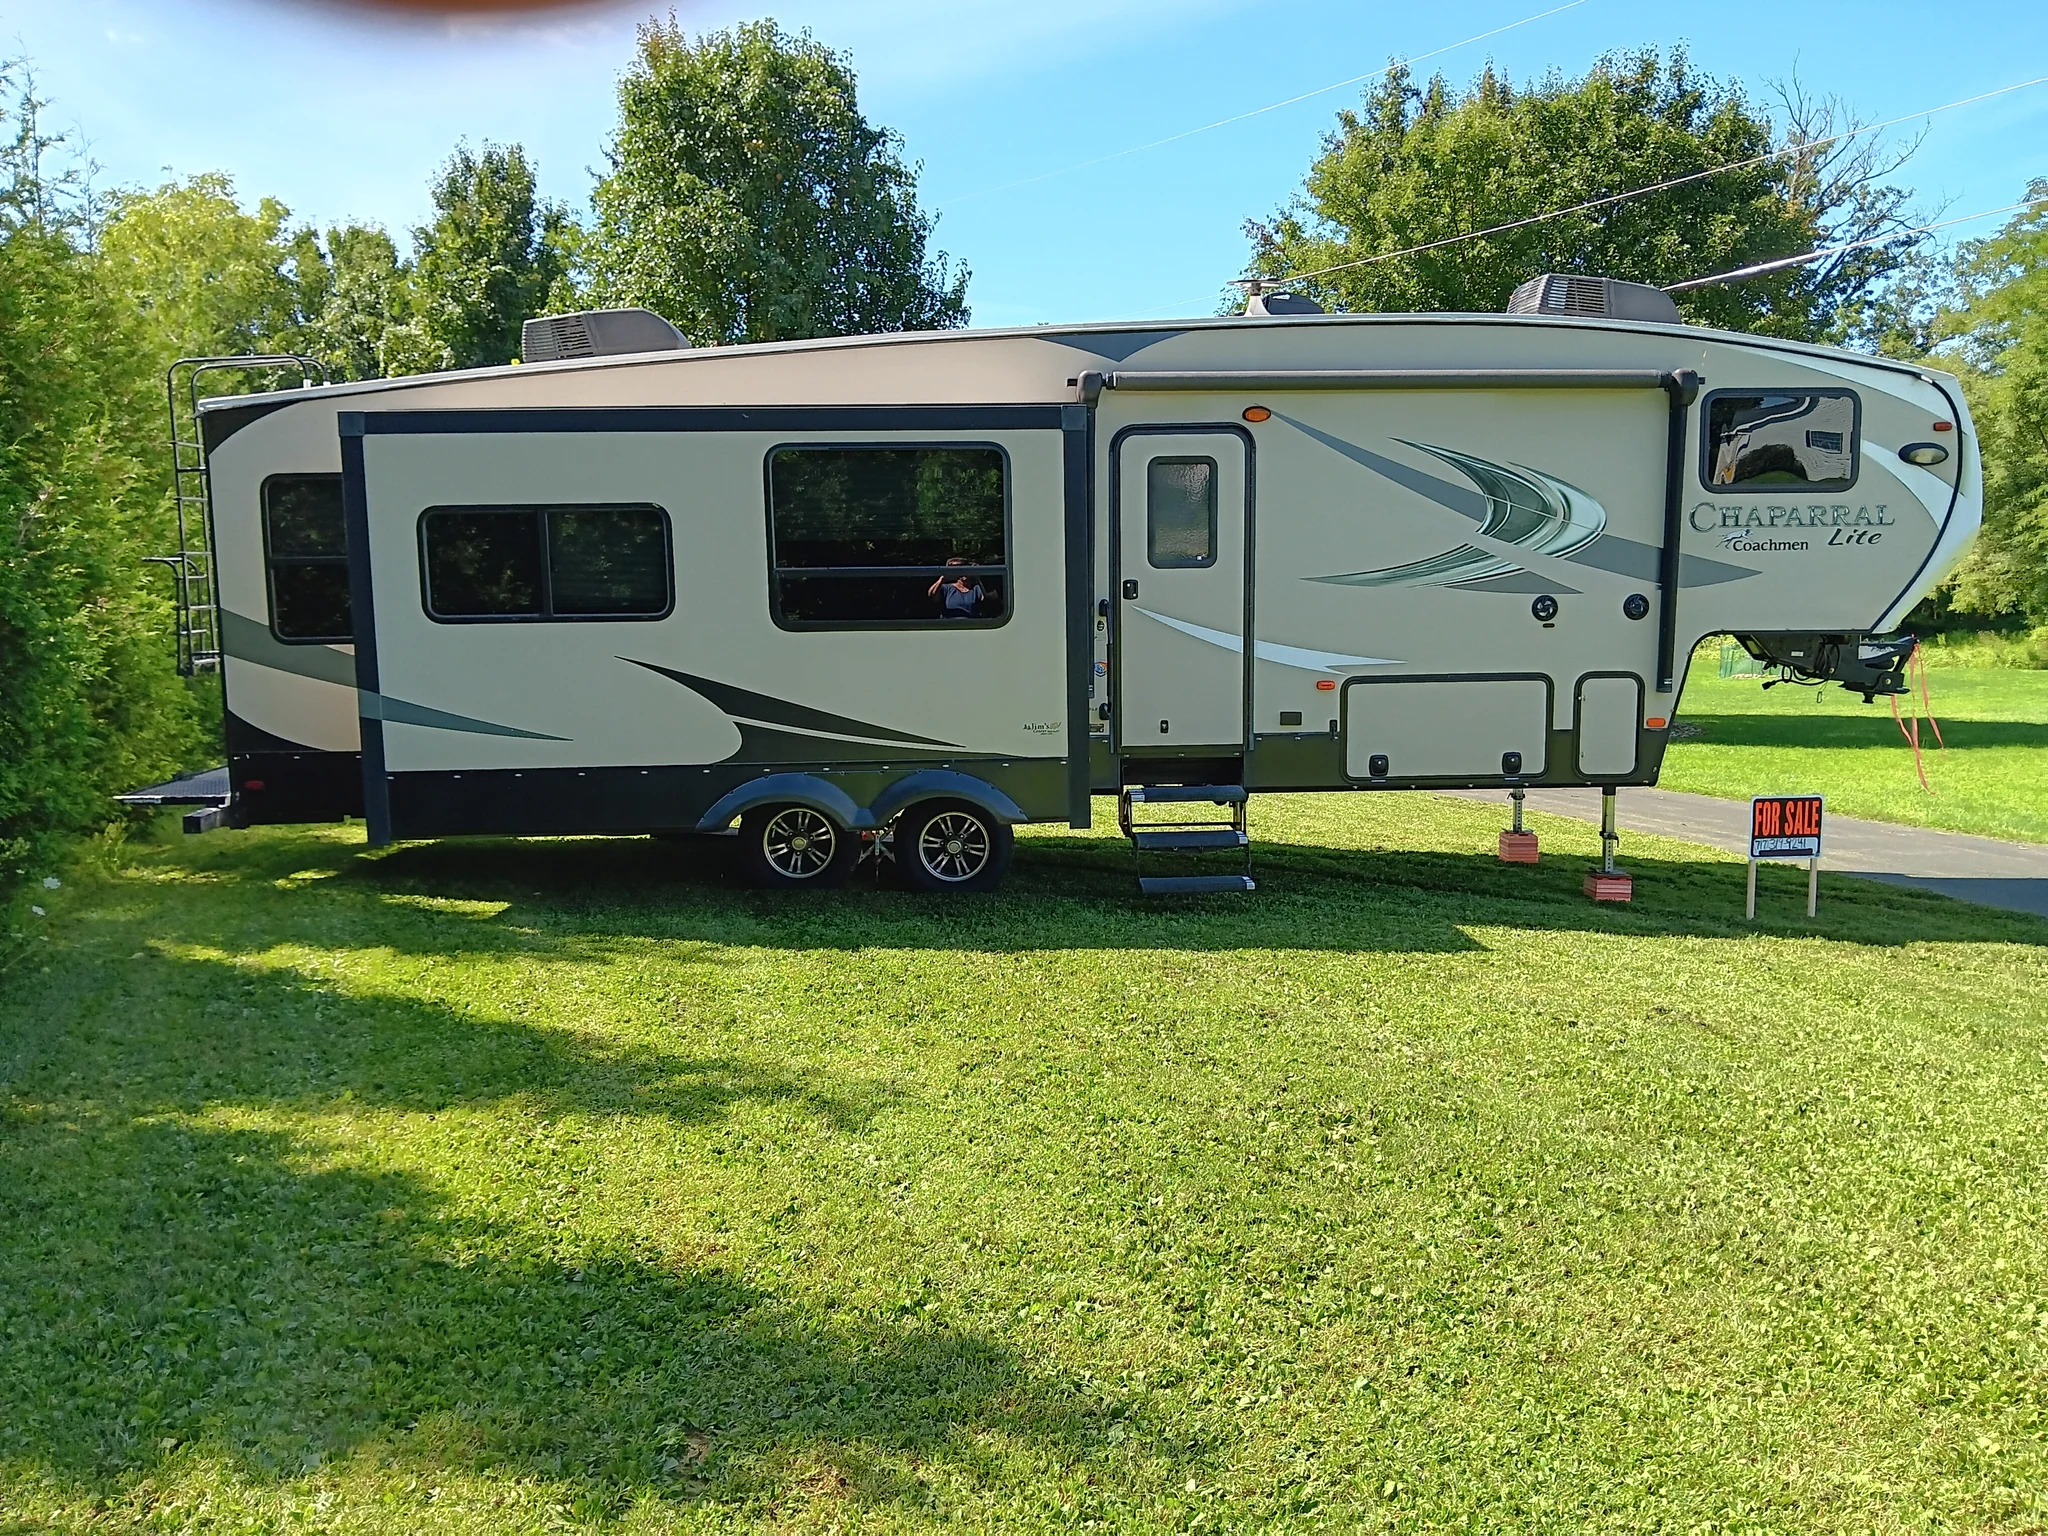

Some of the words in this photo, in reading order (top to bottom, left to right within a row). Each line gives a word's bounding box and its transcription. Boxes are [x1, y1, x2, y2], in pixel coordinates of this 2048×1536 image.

[1689, 501, 1896, 533] CHAPARRAL
[1732, 538, 1809, 552] Coachmen
[1828, 528, 1883, 546] Lite
[1754, 801, 1781, 836] FOR
[1784, 800, 1820, 836] SALE
